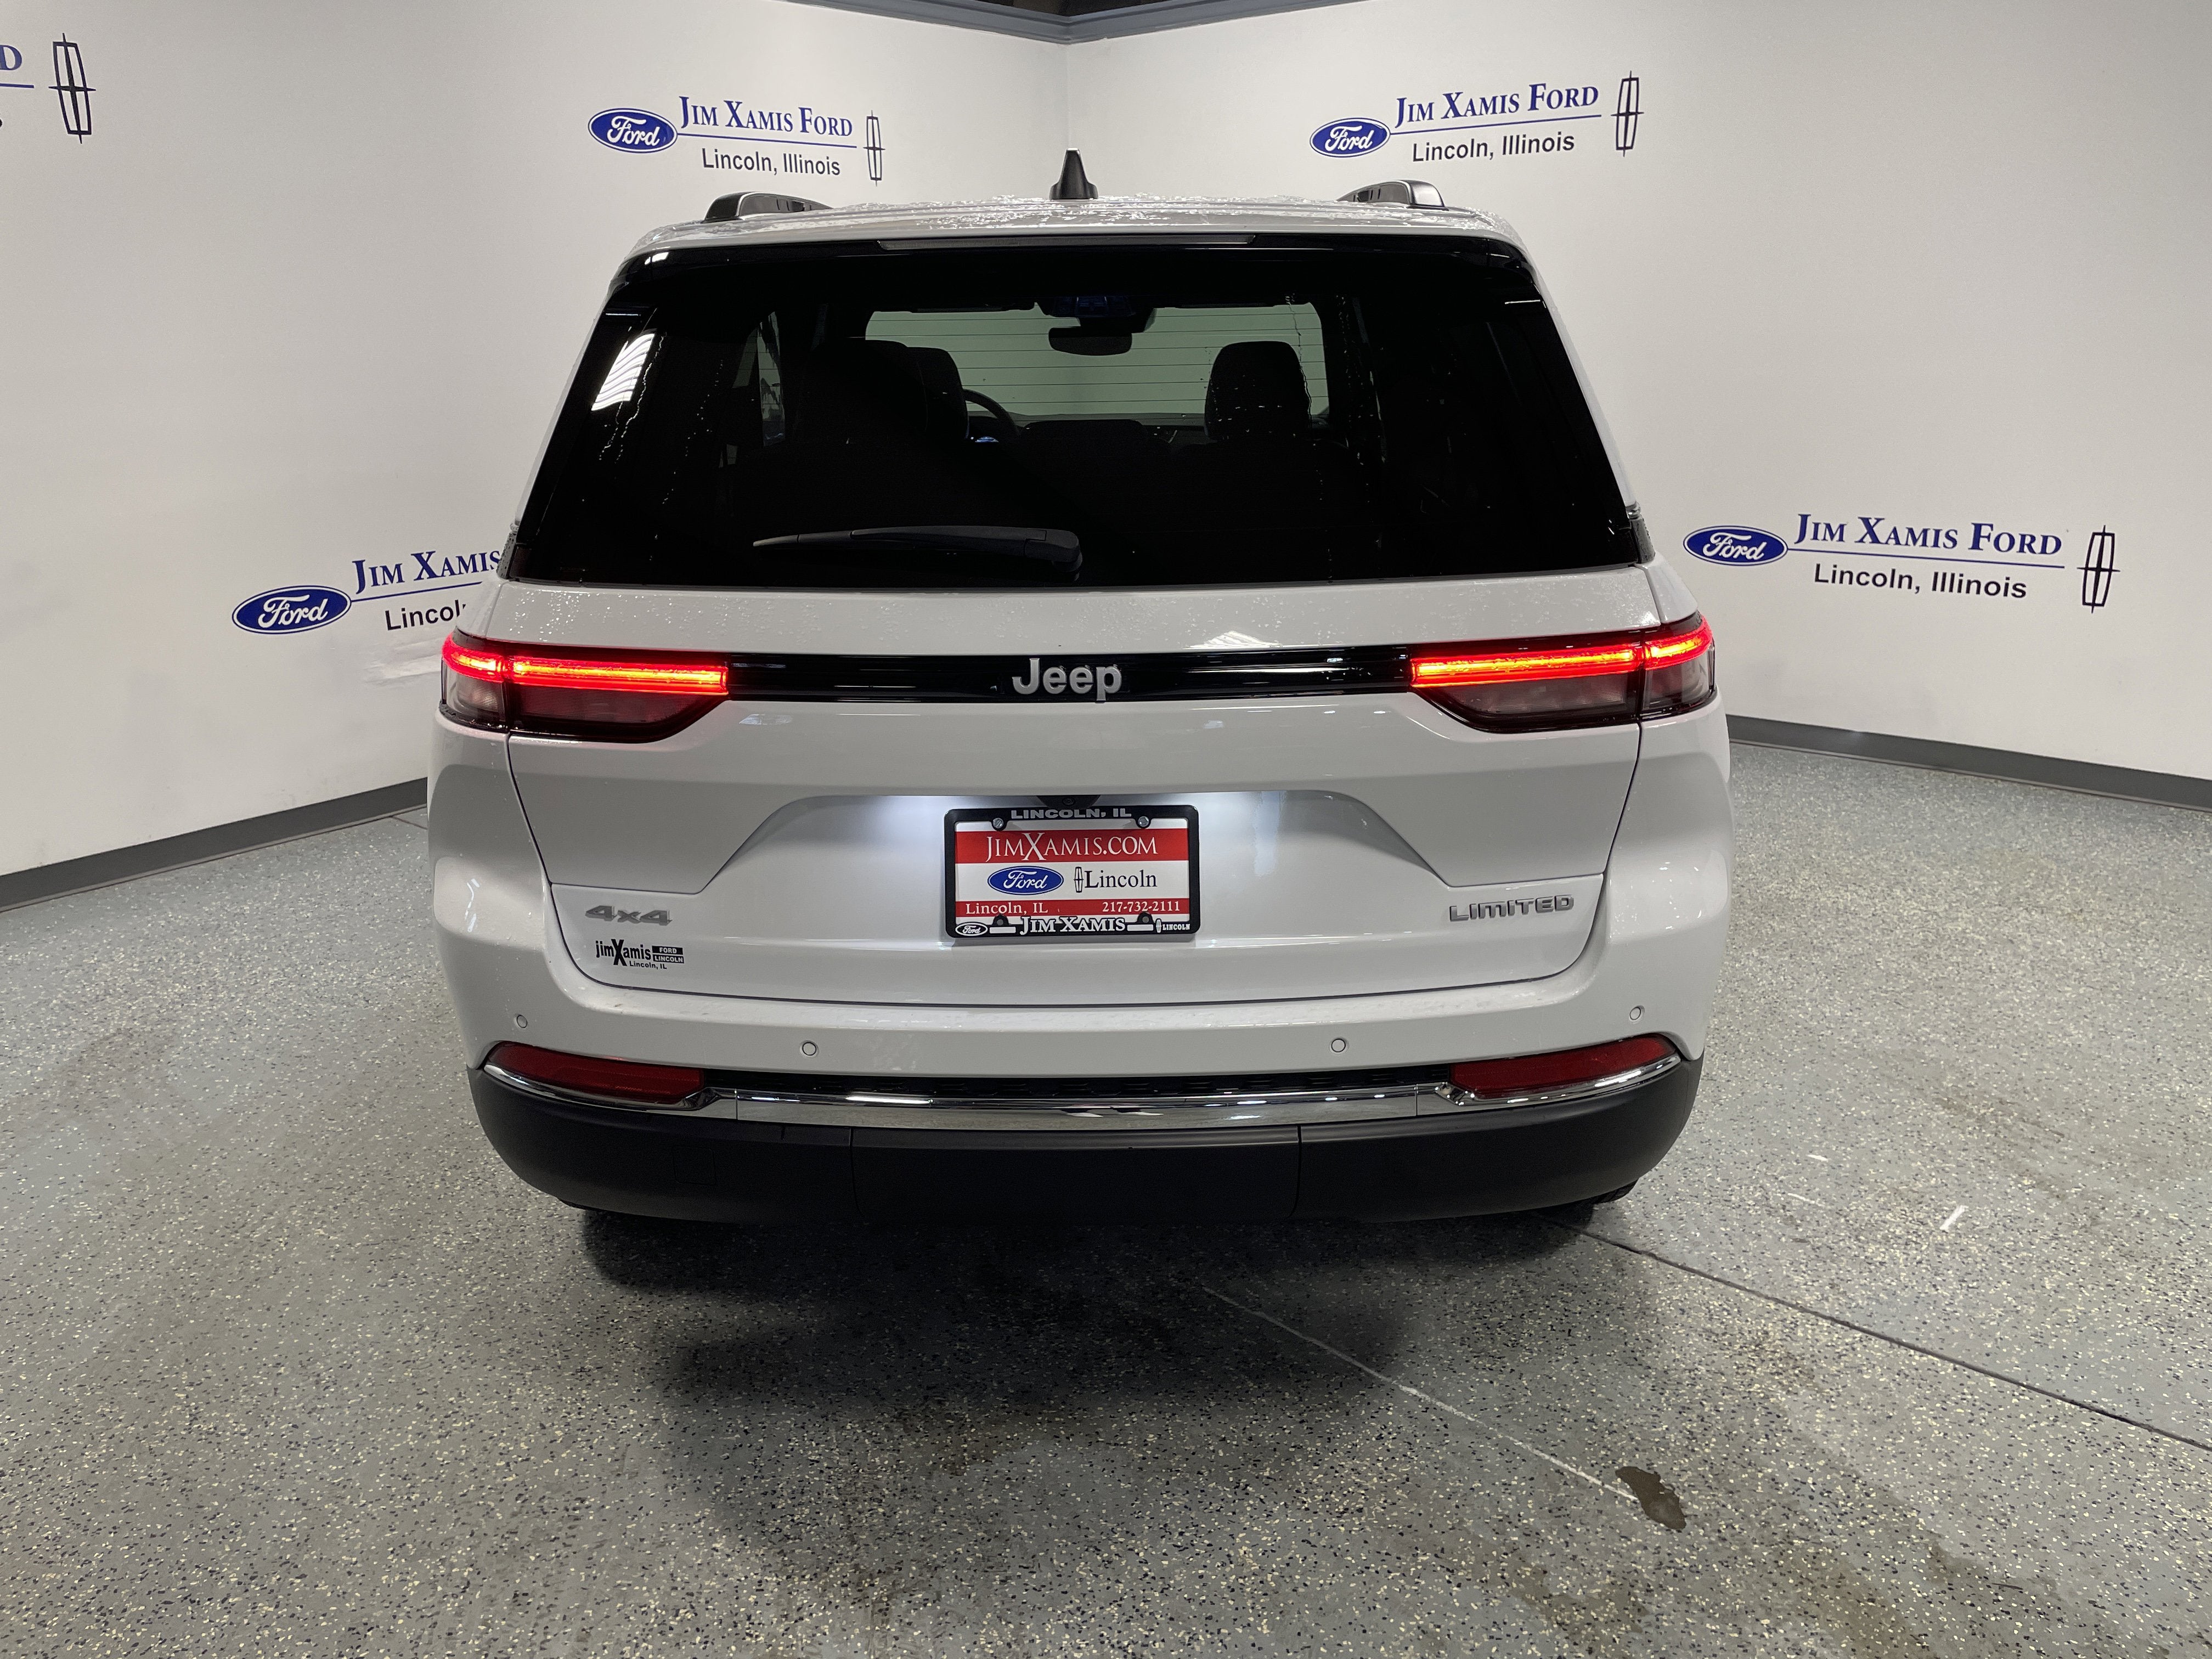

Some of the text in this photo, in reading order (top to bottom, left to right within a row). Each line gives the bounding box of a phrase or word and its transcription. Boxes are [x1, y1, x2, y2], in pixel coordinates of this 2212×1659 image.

[606, 115, 661, 147] Ford
[1324, 126, 1373, 151] Ford
[1412, 132, 1575, 162] Lincoln, Illinois
[702, 148, 840, 176] Lincoln, Illinois
[1703, 531, 1765, 561] Ford
[1814, 563, 2027, 599] Lincoln, Illinois
[257, 595, 329, 628] Ford
[386, 600, 466, 631] Lincol
[1012, 658, 1122, 701] Jeep
[1011, 808, 1132, 819] LINCOLN, IL
[1003, 870, 1048, 889] Ford
[1084, 870, 1158, 888] Lincoln
[966, 902, 1048, 915] Lincoln, IL
[1102, 901, 1180, 913] 217-732-2111
[962, 925, 981, 934] Ford
[596, 939, 651, 966] jimXamis
[629, 960, 658, 969] Lincoln,
